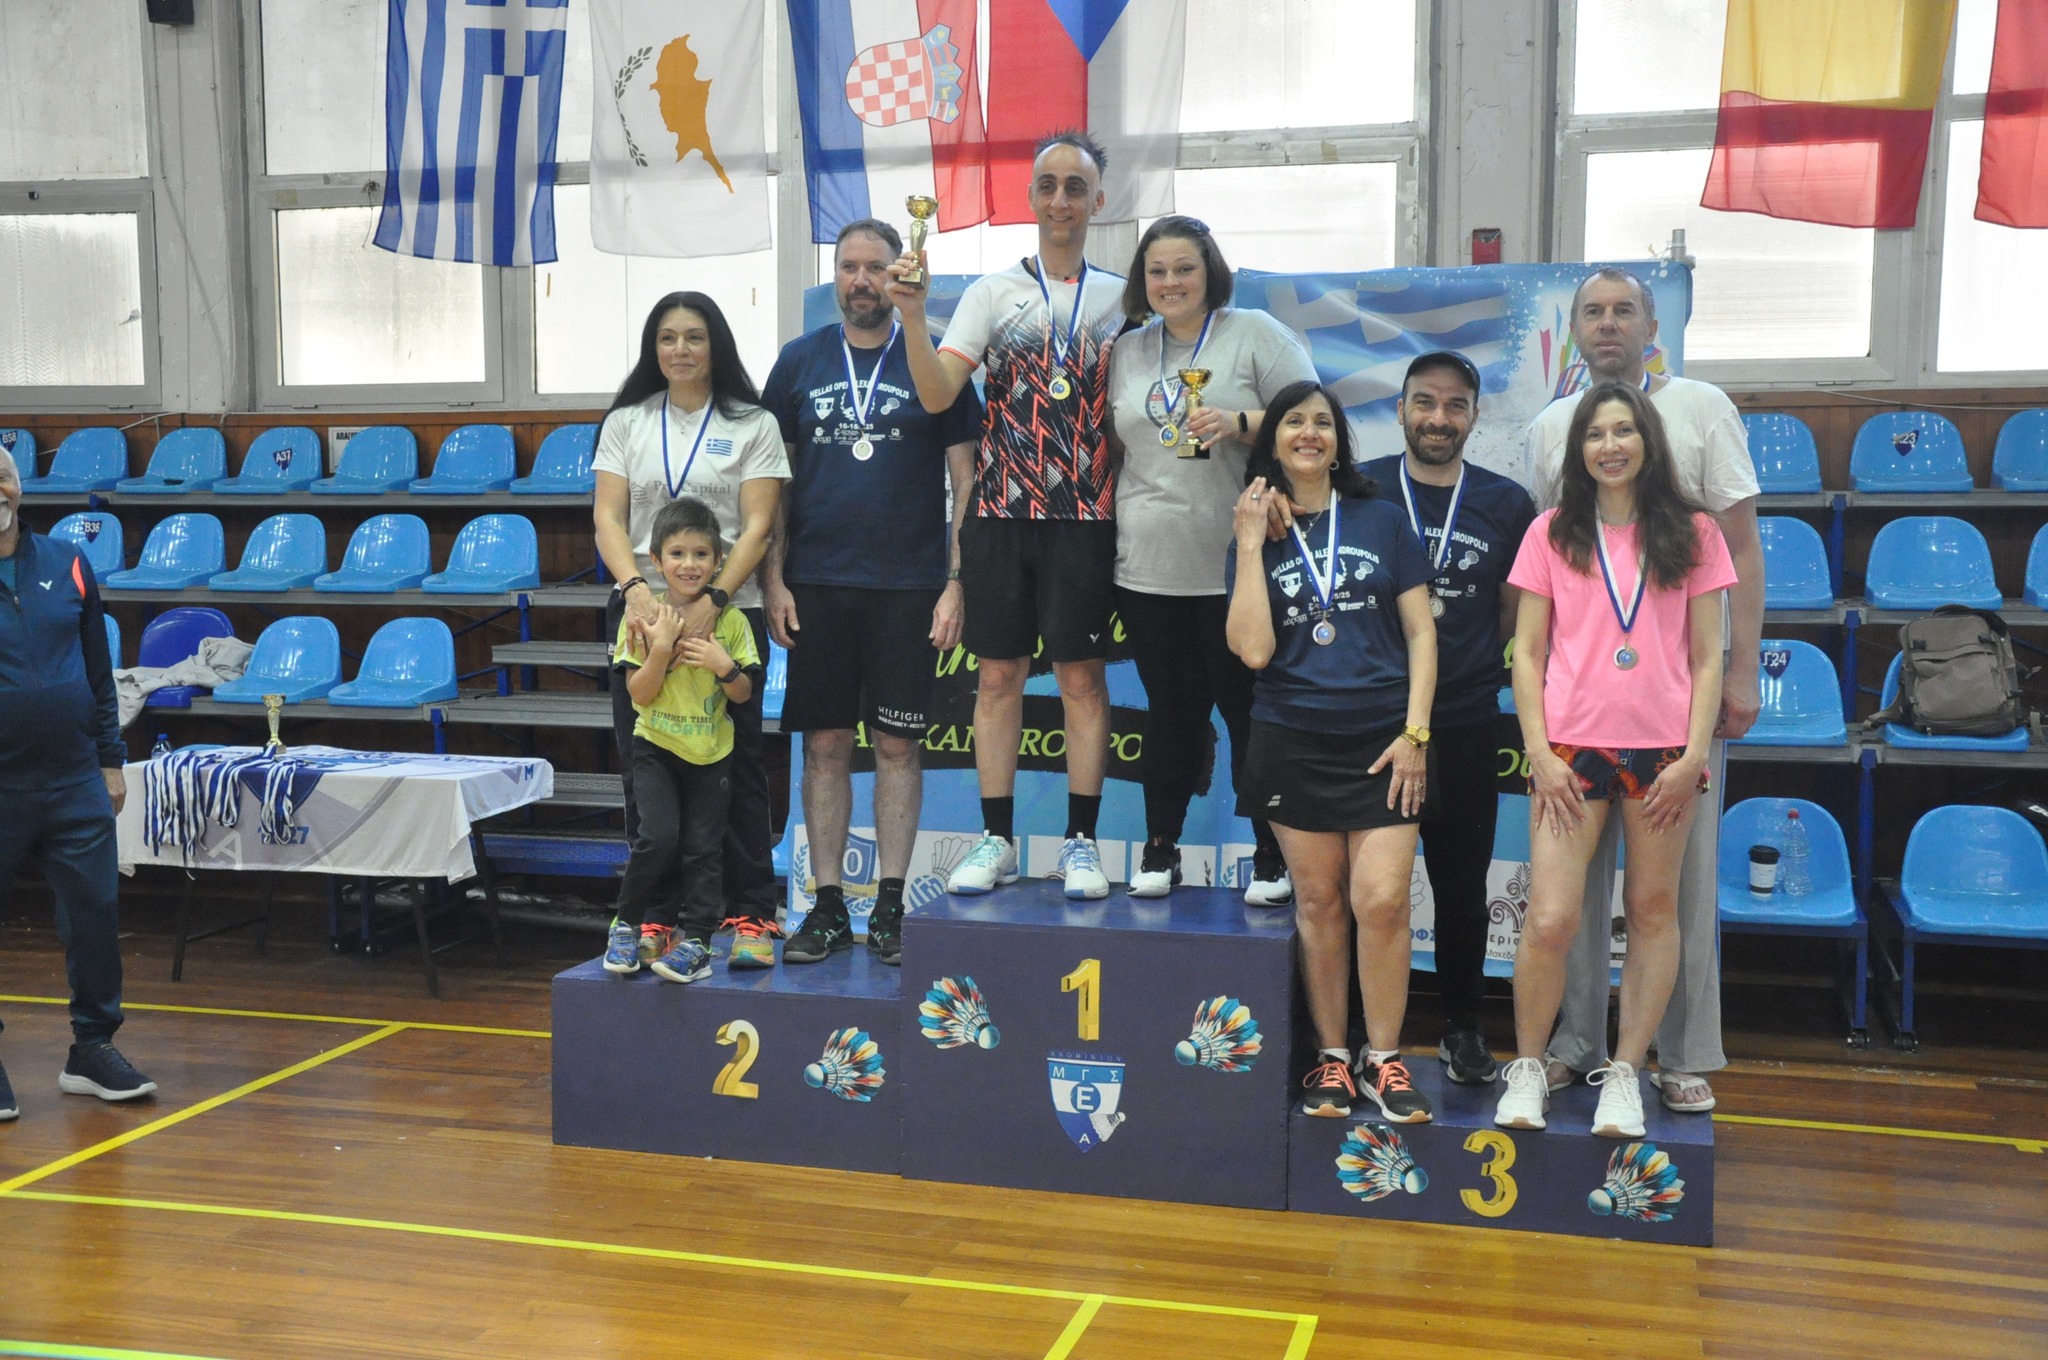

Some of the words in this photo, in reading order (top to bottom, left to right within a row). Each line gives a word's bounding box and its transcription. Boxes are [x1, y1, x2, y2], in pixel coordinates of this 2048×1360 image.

[809, 384, 833, 399] HELLAS
[682, 481, 731, 497] Capital
[84, 521, 101, 533] B36
[1271, 559, 1296, 580] HELLAS
[651, 709, 687, 723] SUMMER
[689, 716, 713, 724] TIME
[878, 705, 924, 722] HILFIGER
[650, 716, 717, 736] VACATI
[1061, 958, 1101, 1041] 1
[712, 1019, 760, 1099] 2
[1050, 1051, 1122, 1063] BADMINTON
[1460, 1129, 1518, 1218] 3
